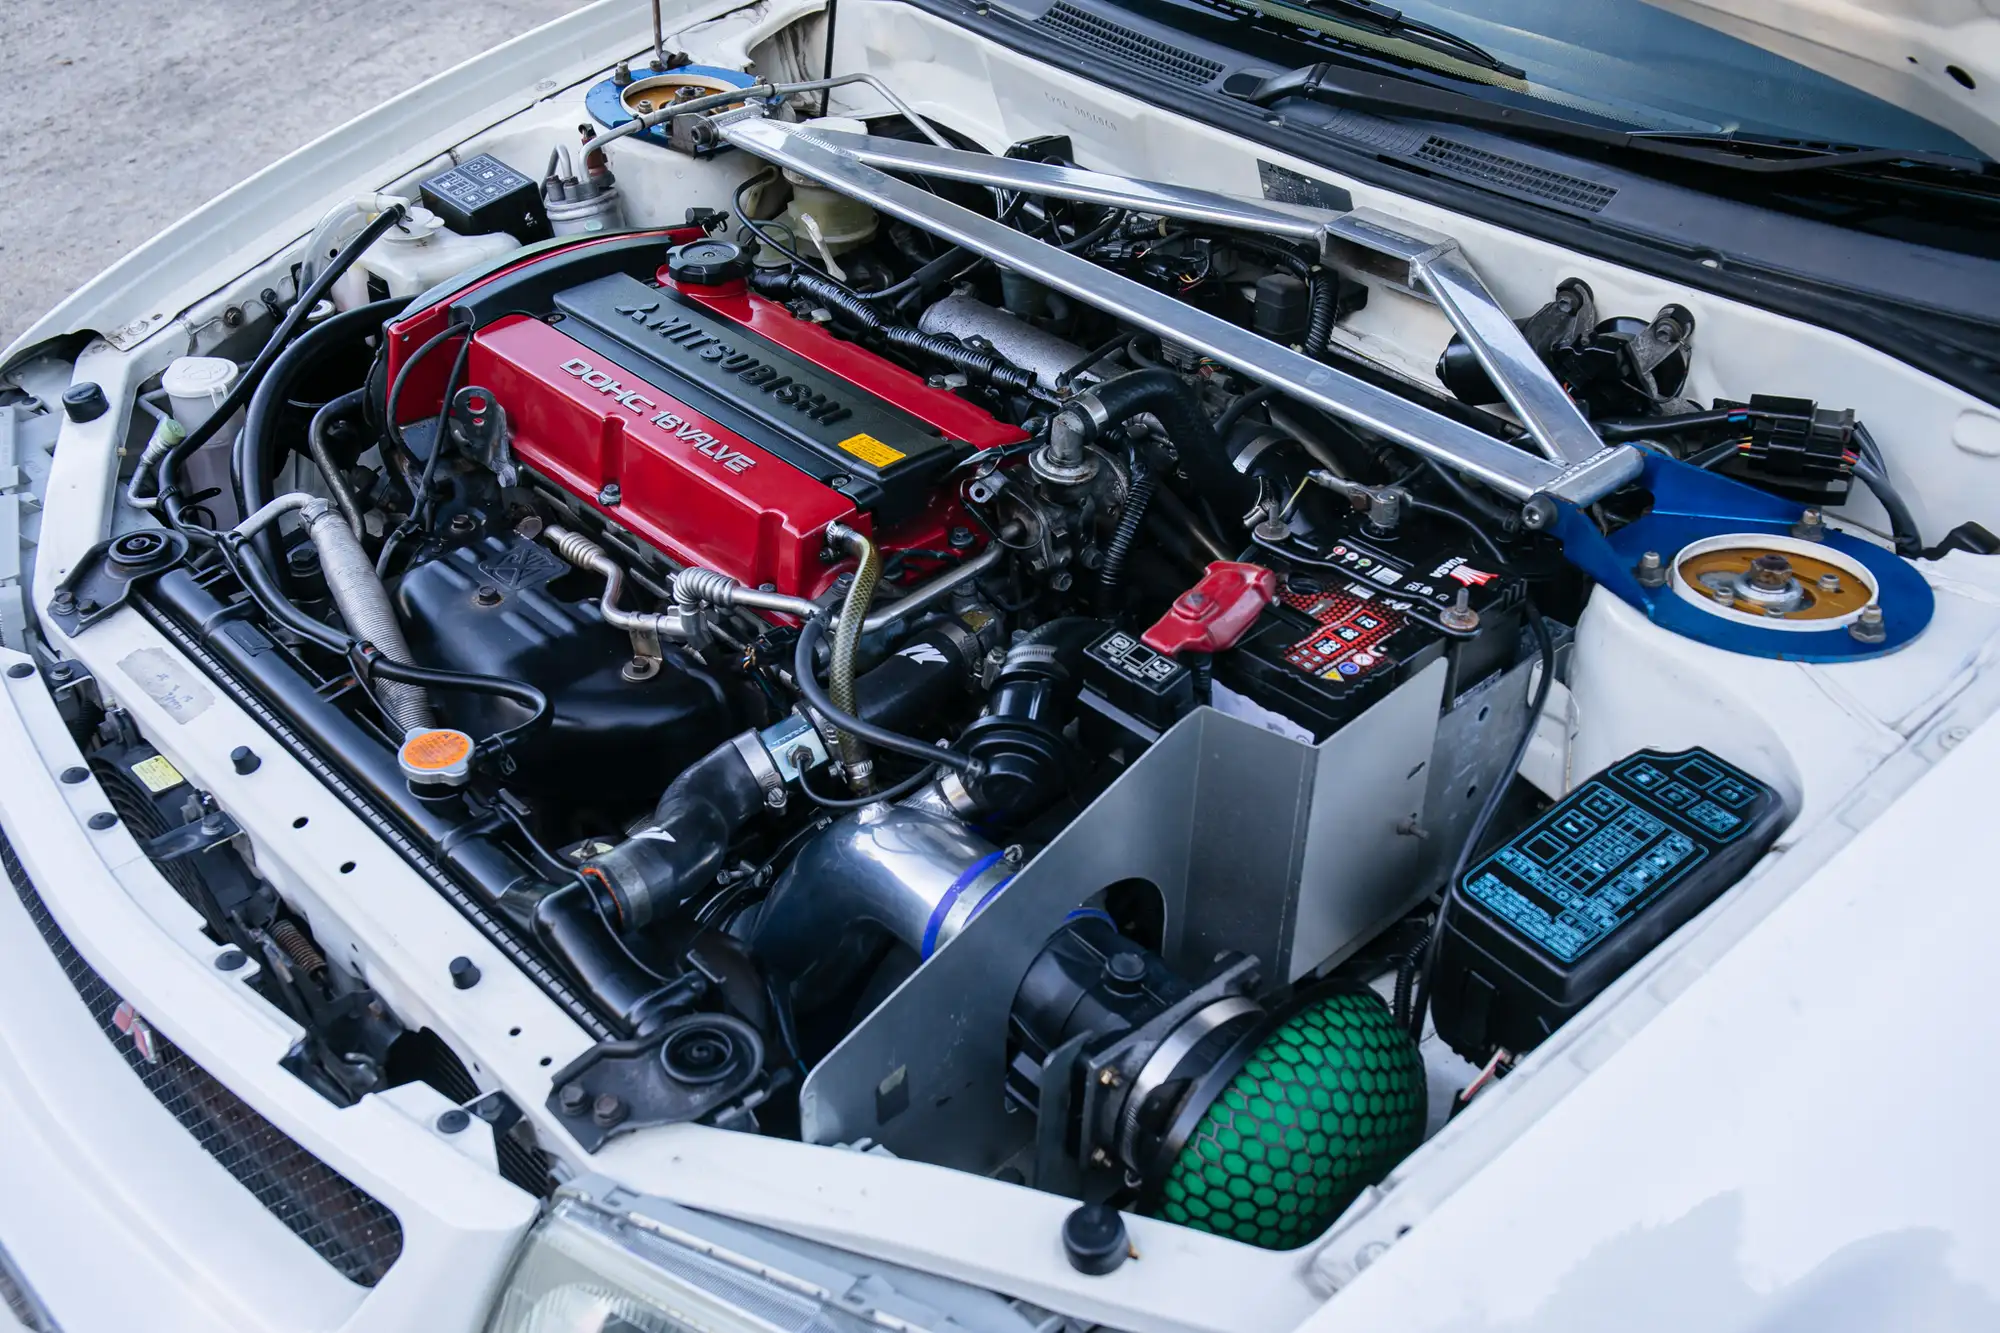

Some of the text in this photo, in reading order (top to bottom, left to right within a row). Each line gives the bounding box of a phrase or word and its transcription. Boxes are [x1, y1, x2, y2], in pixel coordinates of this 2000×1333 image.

[646, 315, 853, 426] MITSUBISHI
[559, 357, 657, 416] DOHC
[1429, 556, 1468, 578] YUASA
[1361, 617, 1378, 629] 12
[1341, 628, 1359, 640] 36
[1318, 640, 1342, 655] 330
